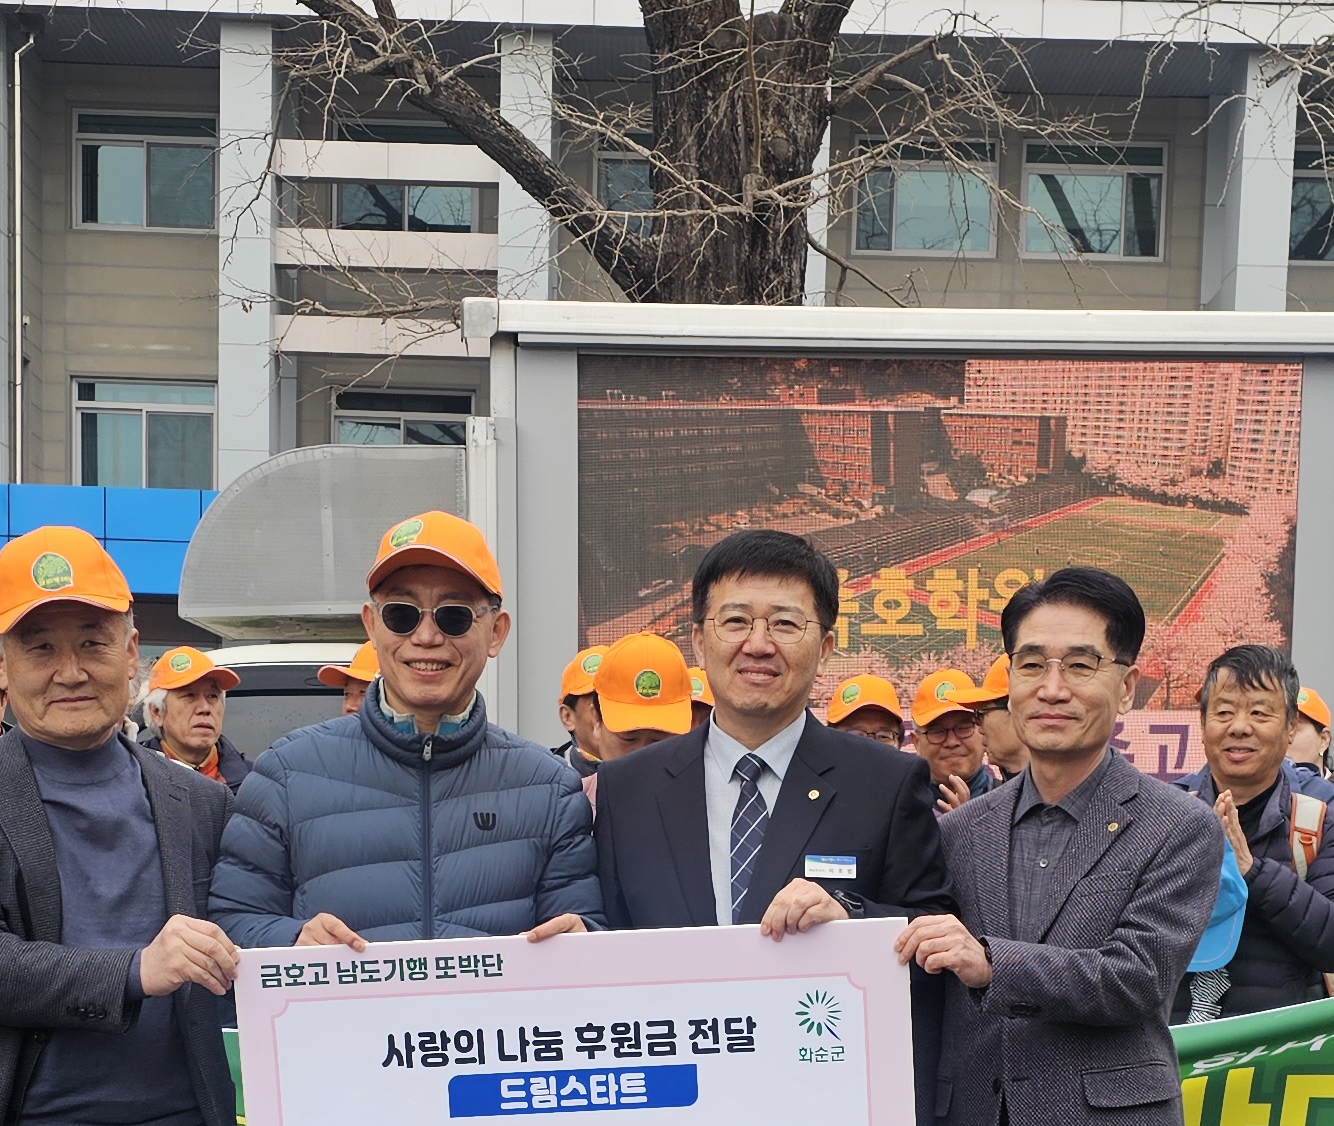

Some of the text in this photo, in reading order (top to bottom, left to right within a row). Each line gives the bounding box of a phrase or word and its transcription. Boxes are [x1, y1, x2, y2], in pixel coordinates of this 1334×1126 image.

[261, 954, 503, 988] 금호고 남도기행 또박단
[382, 1016, 756, 1068] 사랑의 나눔 후원금 전달
[799, 1046, 844, 1062] 화순군
[499, 1071, 648, 1110] 드림스타트
